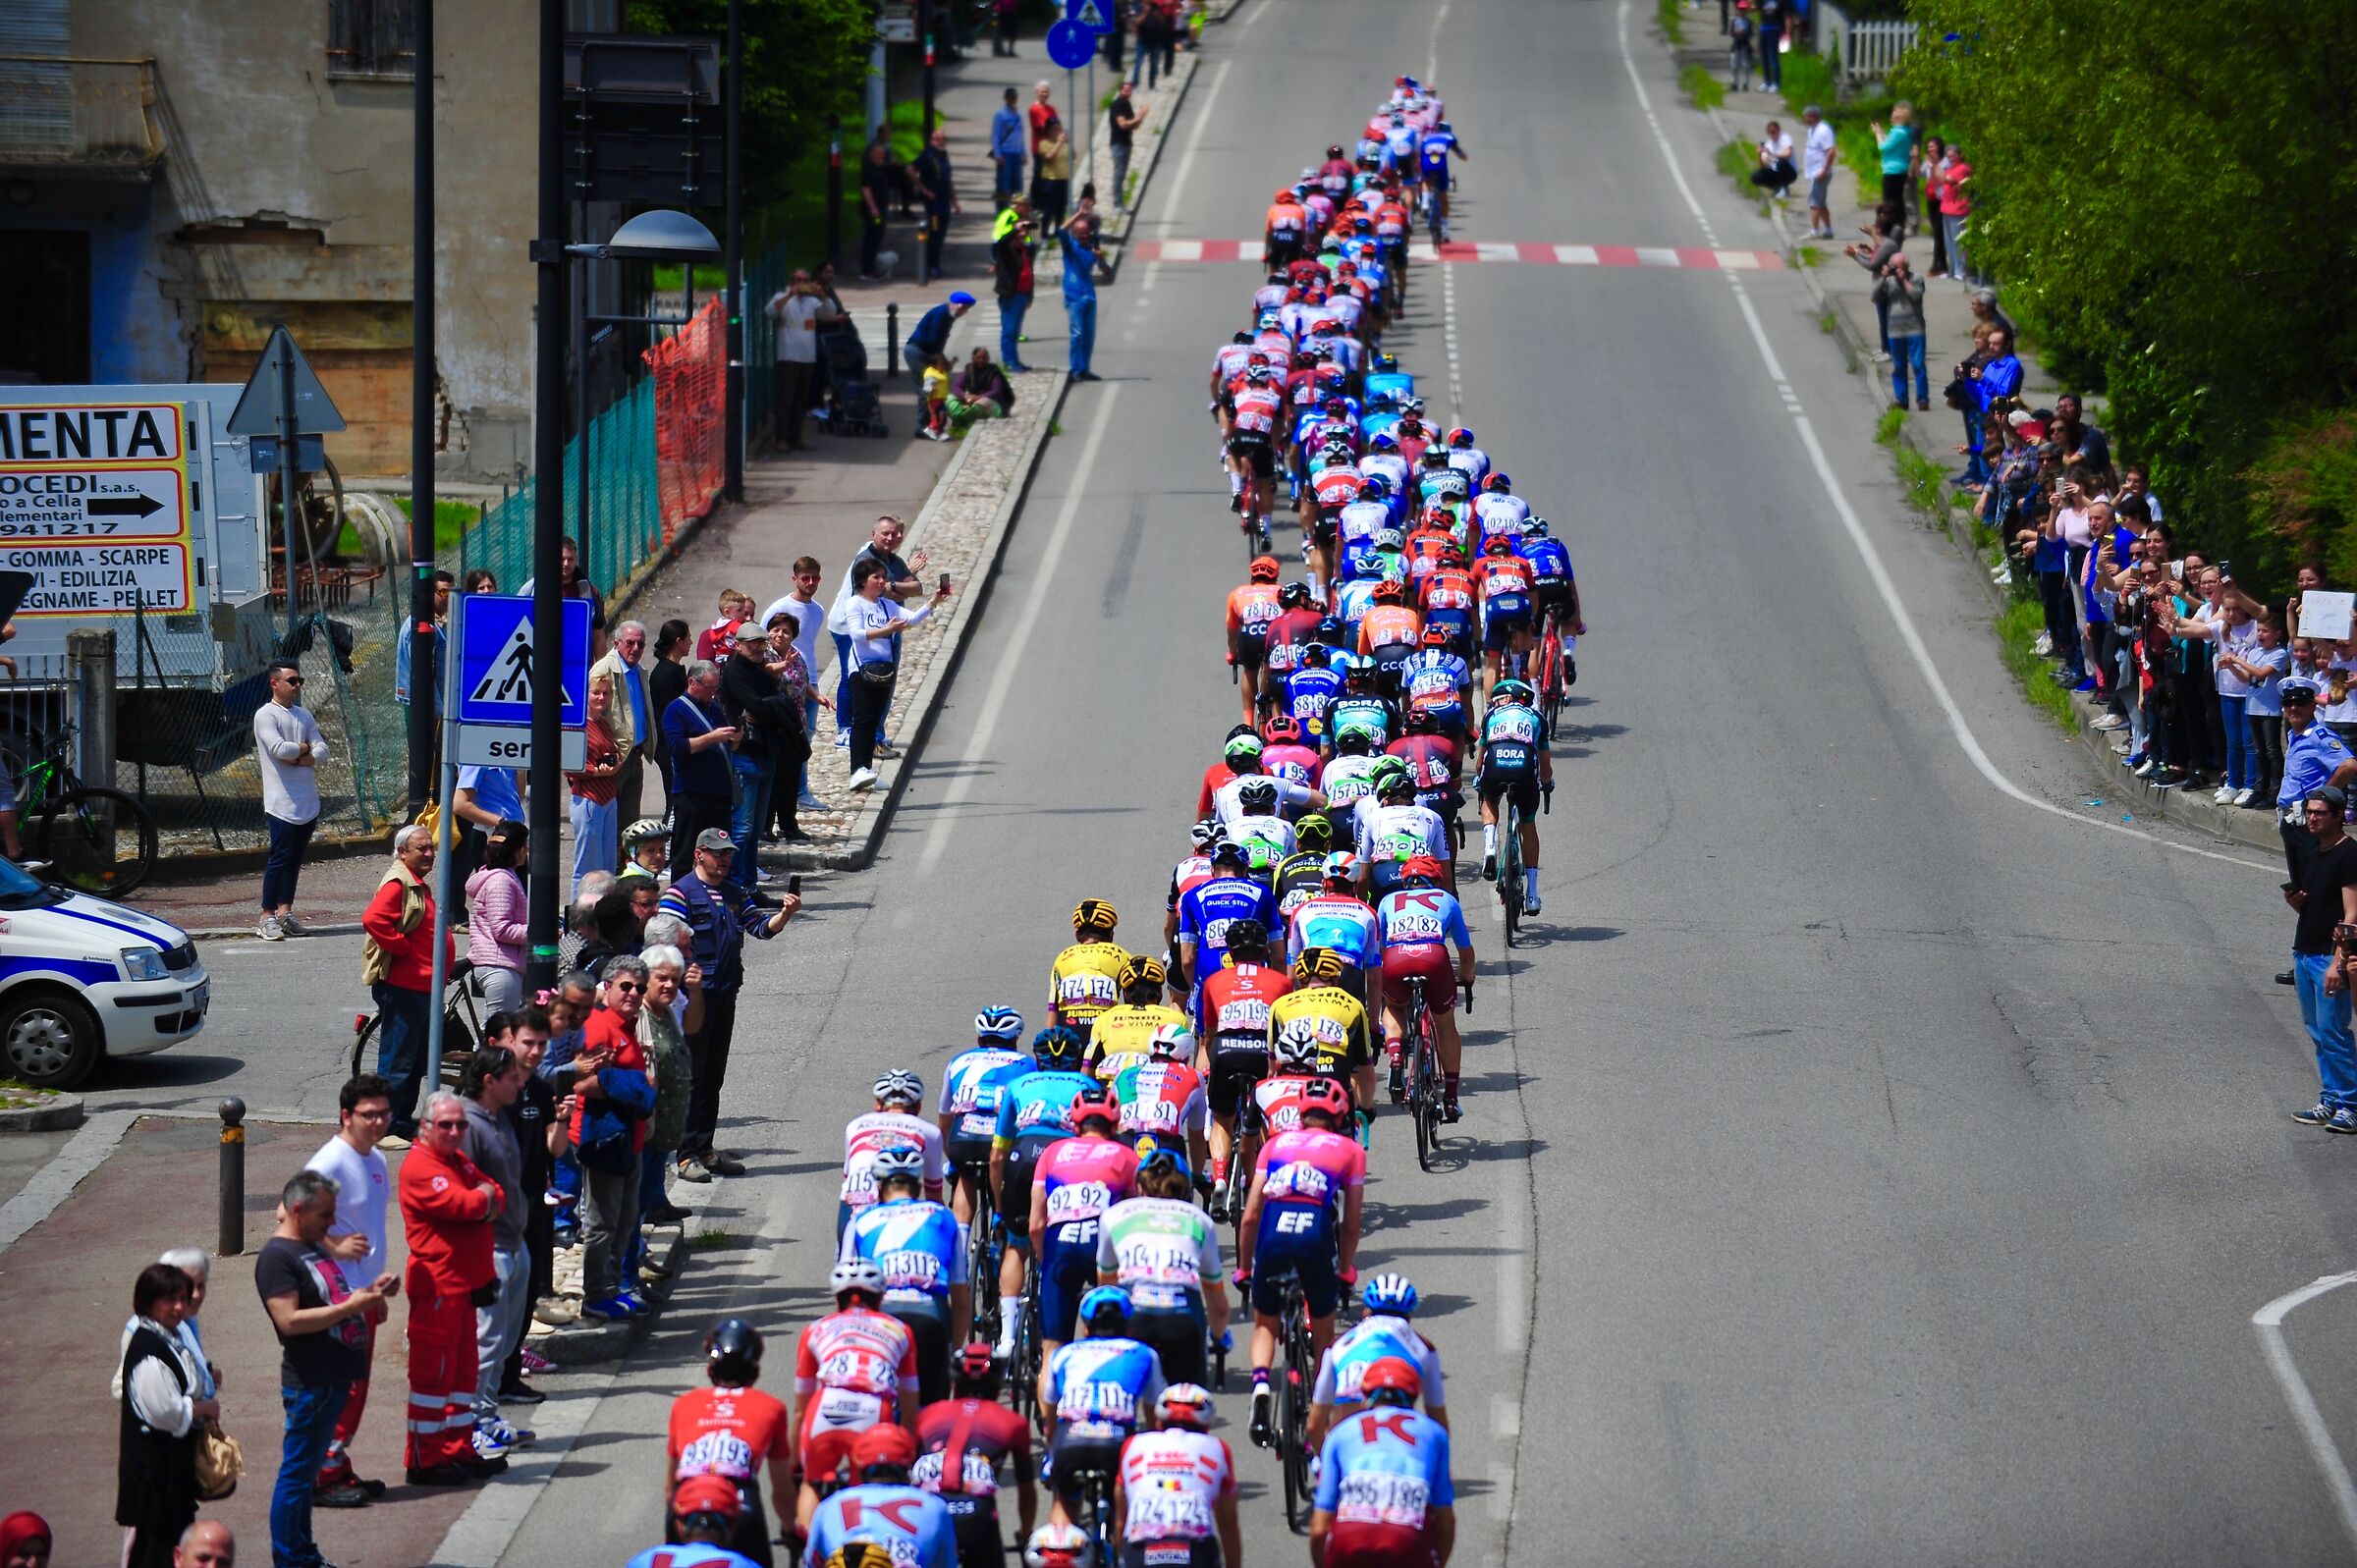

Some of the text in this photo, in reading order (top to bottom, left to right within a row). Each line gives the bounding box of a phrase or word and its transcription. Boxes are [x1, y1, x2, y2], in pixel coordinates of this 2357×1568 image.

[101, 480, 139, 493] s.a.s.
[16, 498, 27, 508] a
[32, 495, 82, 508] Cella
[1, 523, 119, 535] 941217
[9, 551, 84, 568] GOMMA
[99, 549, 170, 567] SCARPE
[61, 569, 137, 587] EDILIZIA
[1489, 574, 1523, 587] 45 45
[20, 591, 98, 609] EGNAME
[114, 589, 178, 607] PELET
[1432, 591, 1444, 602] 47
[1267, 603, 1280, 616] 78
[1248, 624, 1267, 635] CC
[1295, 696, 1310, 712] 88
[1338, 699, 1384, 709] BORA
[1493, 721, 1531, 737] 66 66
[488, 740, 531, 758] ser
[1496, 749, 1525, 759] BORA
[1290, 765, 1305, 781] 95
[1284, 858, 1323, 873] MITCHEL
[1203, 884, 1254, 894] deceuninck
[1394, 892, 1444, 913] K
[1208, 921, 1226, 940] 86
[1393, 916, 1414, 934] 182
[1401, 943, 1429, 952] Alpecin
[1063, 978, 1114, 1000] 174 174
[1067, 1009, 1104, 1018] JUMBO
[1318, 1018, 1343, 1040] 178
[1124, 1102, 1170, 1120] 81 81
[847, 1172, 873, 1192] 115
[1052, 1189, 1101, 1211] 92 92
[1276, 1210, 1315, 1234] EF
[1058, 1220, 1098, 1244] EF
[1361, 1414, 1416, 1445] K
[841, 1497, 922, 1535] K
